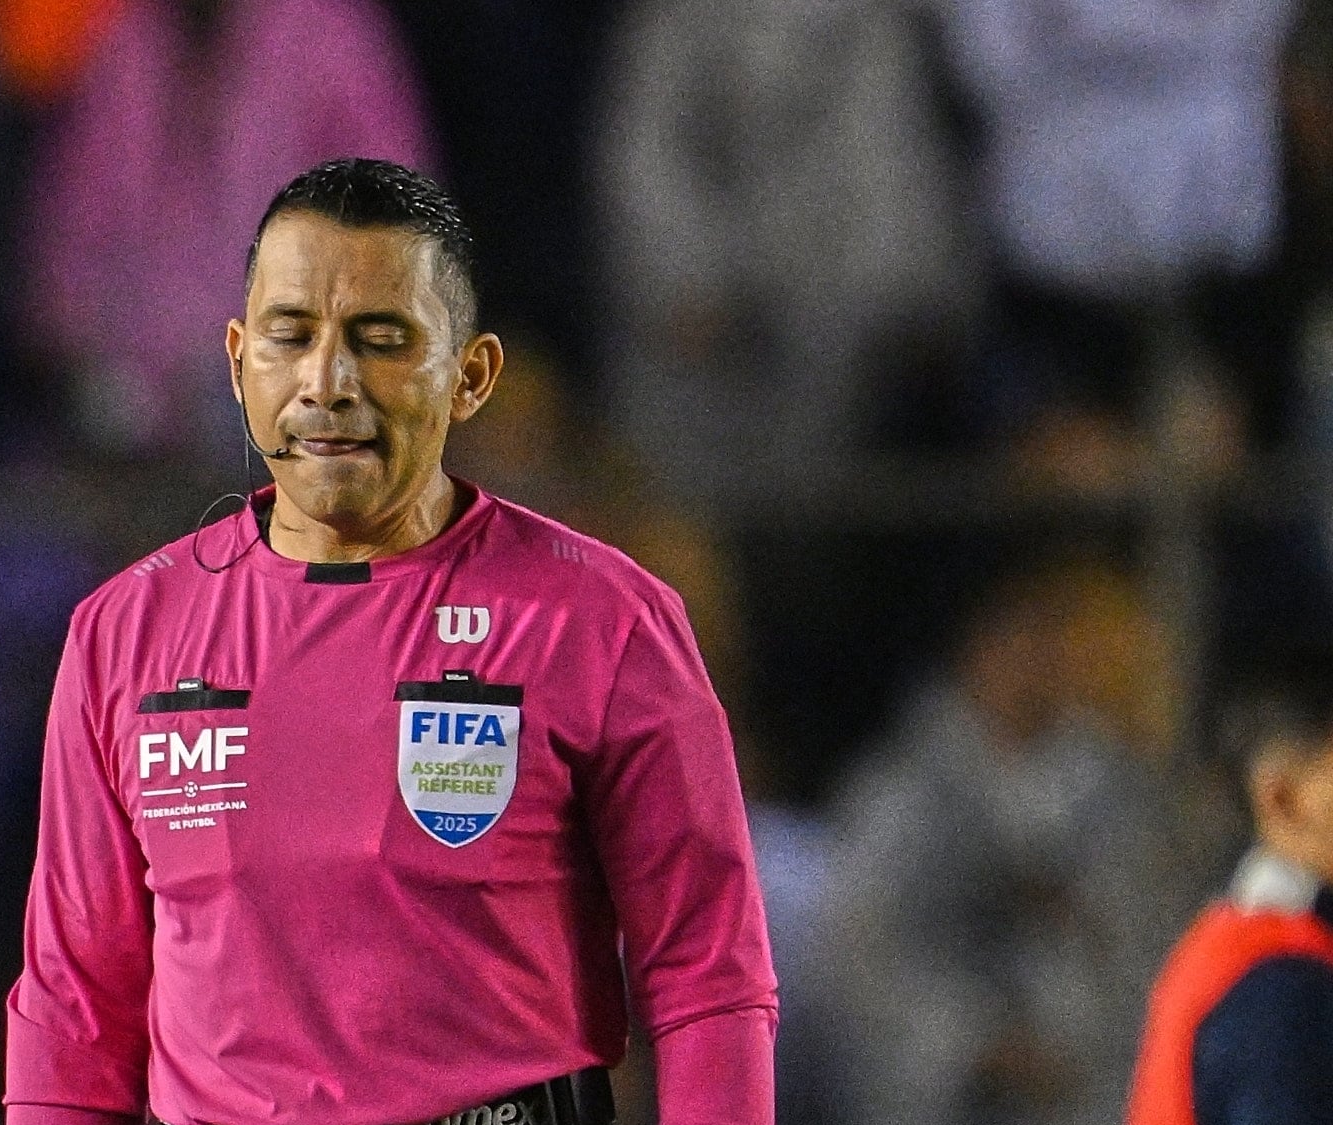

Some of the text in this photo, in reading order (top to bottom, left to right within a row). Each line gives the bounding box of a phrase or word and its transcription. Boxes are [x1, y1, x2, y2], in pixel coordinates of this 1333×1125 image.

[411, 711, 507, 746] FIFA
[139, 727, 249, 779] FMF
[411, 761, 505, 778] ASSISTANT
[417, 778, 497, 795] REFEREE
[197, 800, 247, 814] MEXICANA
[169, 818, 217, 830] DE FUTBOL
[433, 816, 477, 832] 2025
